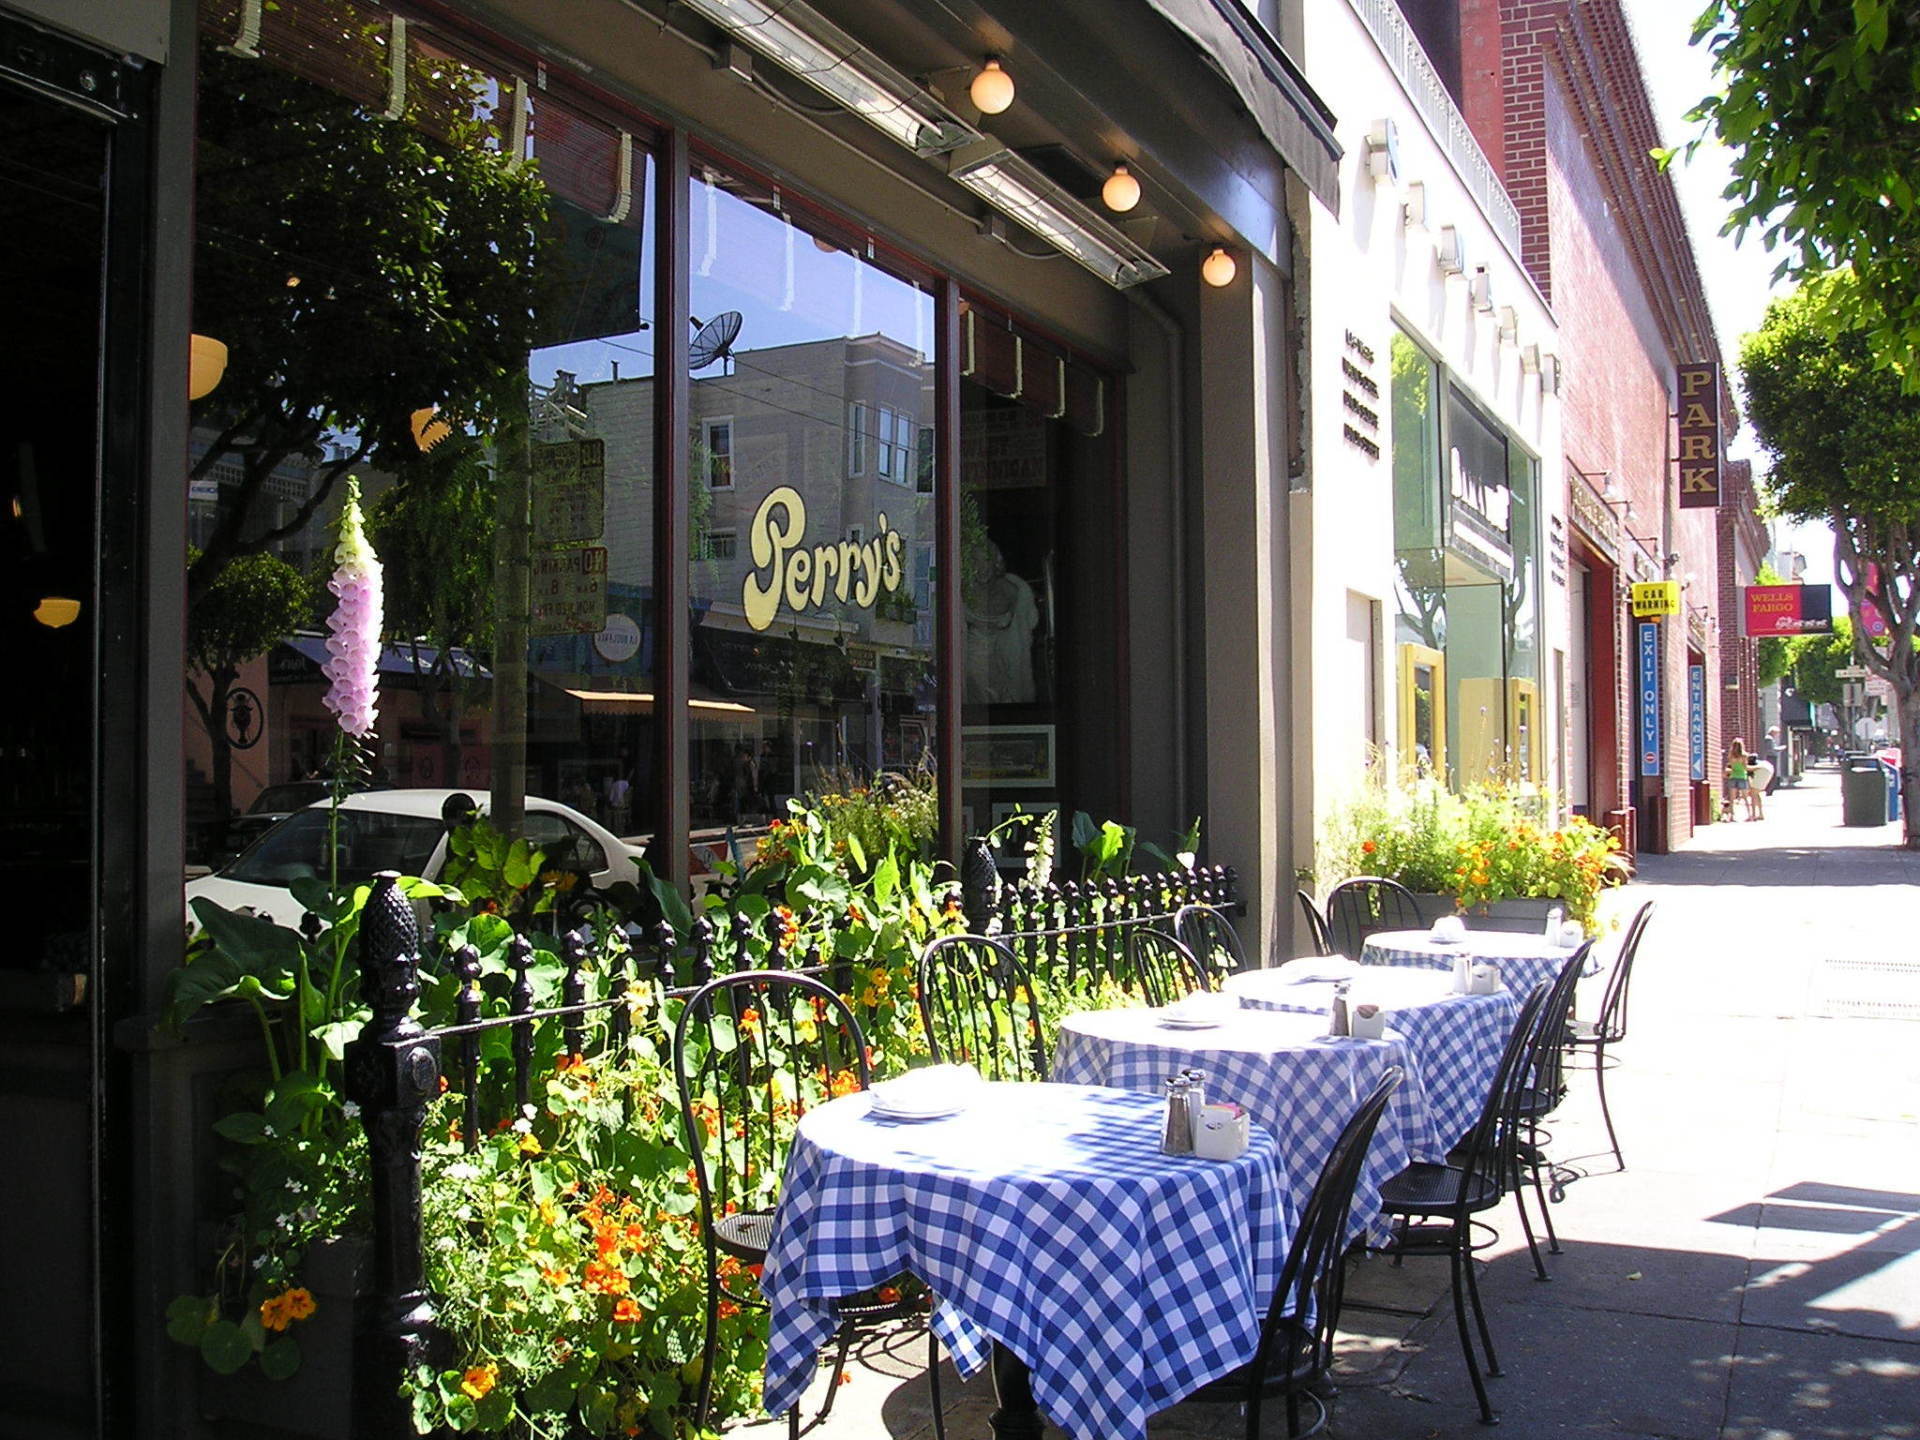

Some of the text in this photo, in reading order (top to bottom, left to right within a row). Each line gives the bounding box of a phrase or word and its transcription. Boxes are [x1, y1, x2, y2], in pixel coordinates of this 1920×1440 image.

[1680, 371, 1716, 494] PARK
[743, 485, 902, 631] Perry's
[1634, 599, 1675, 610] WARNING
[1643, 589, 1664, 599] CAR
[1751, 593, 1793, 603] WELLS
[1752, 603, 1793, 612] FARGO
[1644, 631, 1655, 741] EXIT ONLY
[1692, 671, 1703, 754] ENTRANCE
